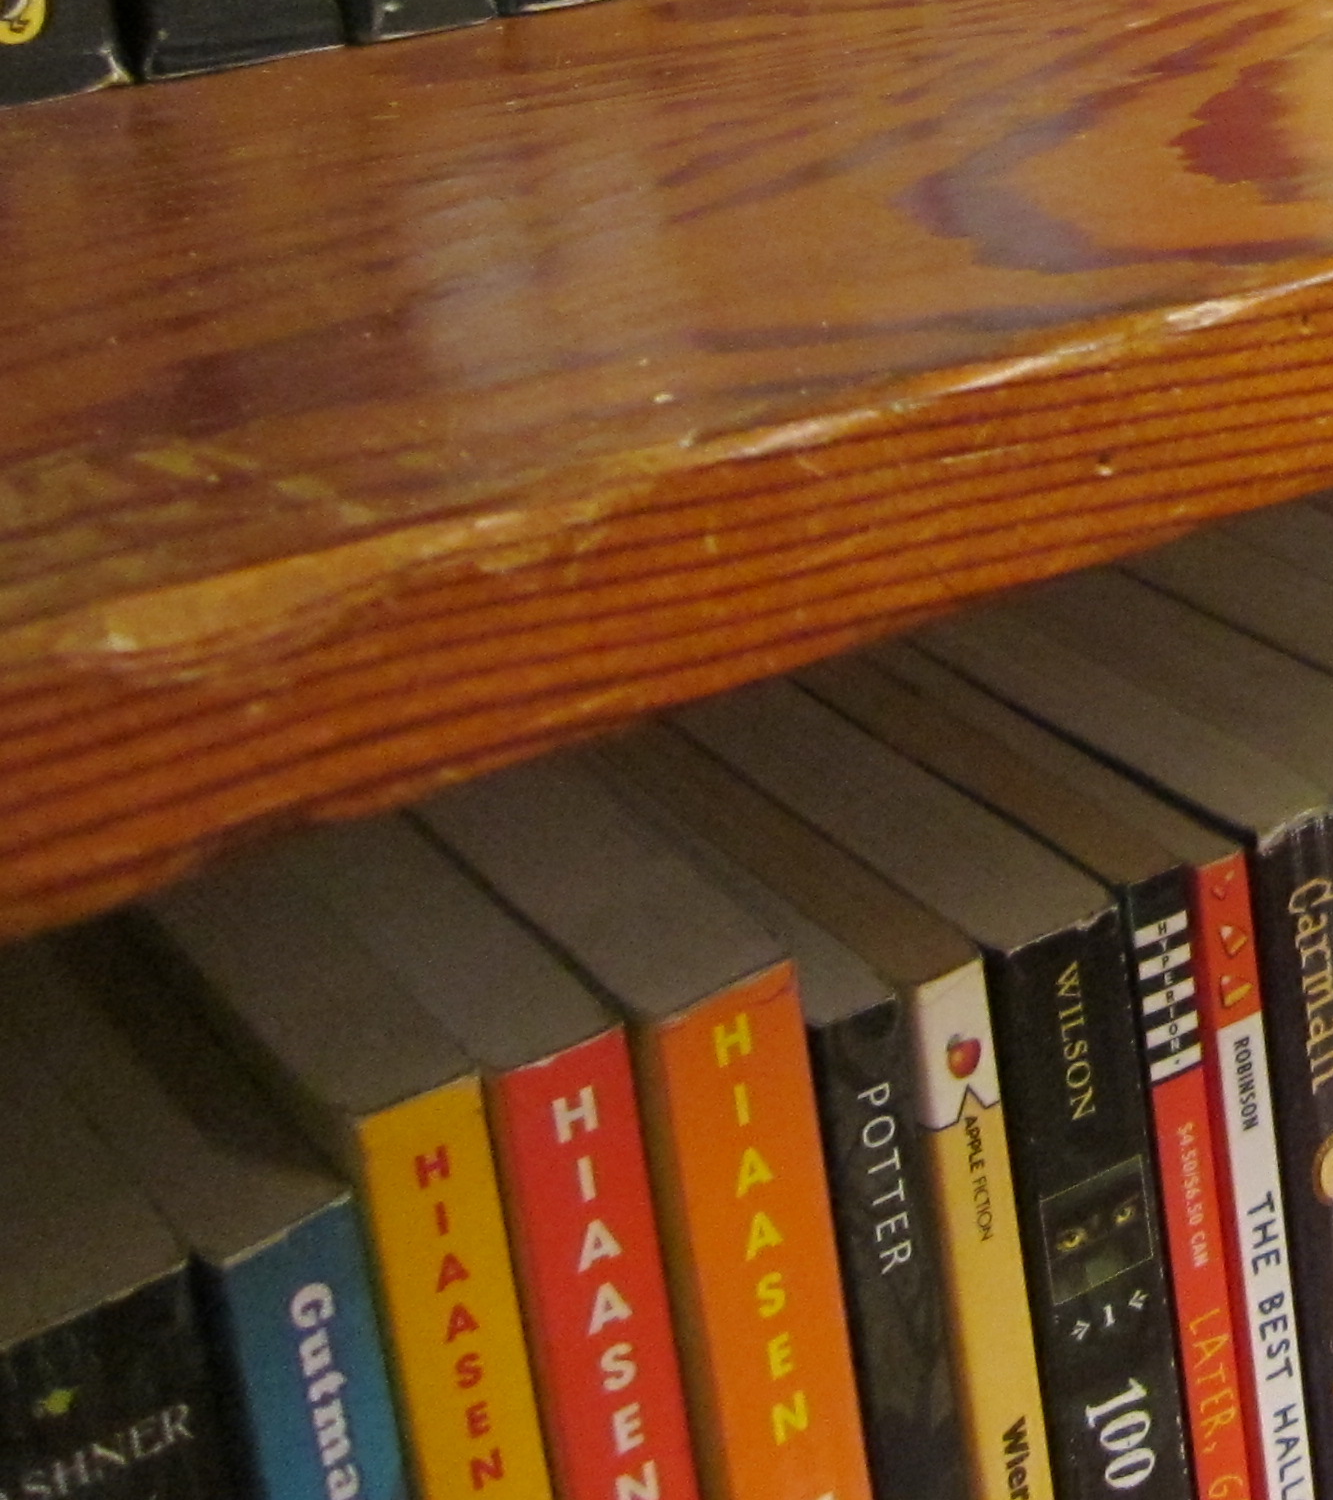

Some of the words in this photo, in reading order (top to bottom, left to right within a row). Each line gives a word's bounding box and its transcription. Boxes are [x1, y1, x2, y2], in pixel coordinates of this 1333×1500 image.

[1053, 959, 1096, 1122] WILSON
[1157, 920, 1181, 1053] HYPERION
[961, 1114, 988, 1173] APPLE
[1233, 1036, 1259, 1133] ROBINSON
[711, 1012, 810, 1447] HIASEN
[857, 1081, 913, 1275] POTTER
[970, 1176, 994, 1242] FICTION
[1246, 1190, 1282, 1276] THE
[551, 1085, 661, 1500] HIASEN
[1190, 1231, 1208, 1269] CAN
[414, 1144, 506, 1491] HIASEN
[1258, 1289, 1294, 1381] BEST
[1084, 1377, 1154, 1490] 100
[1189, 1305, 1227, 1454] LATER,
